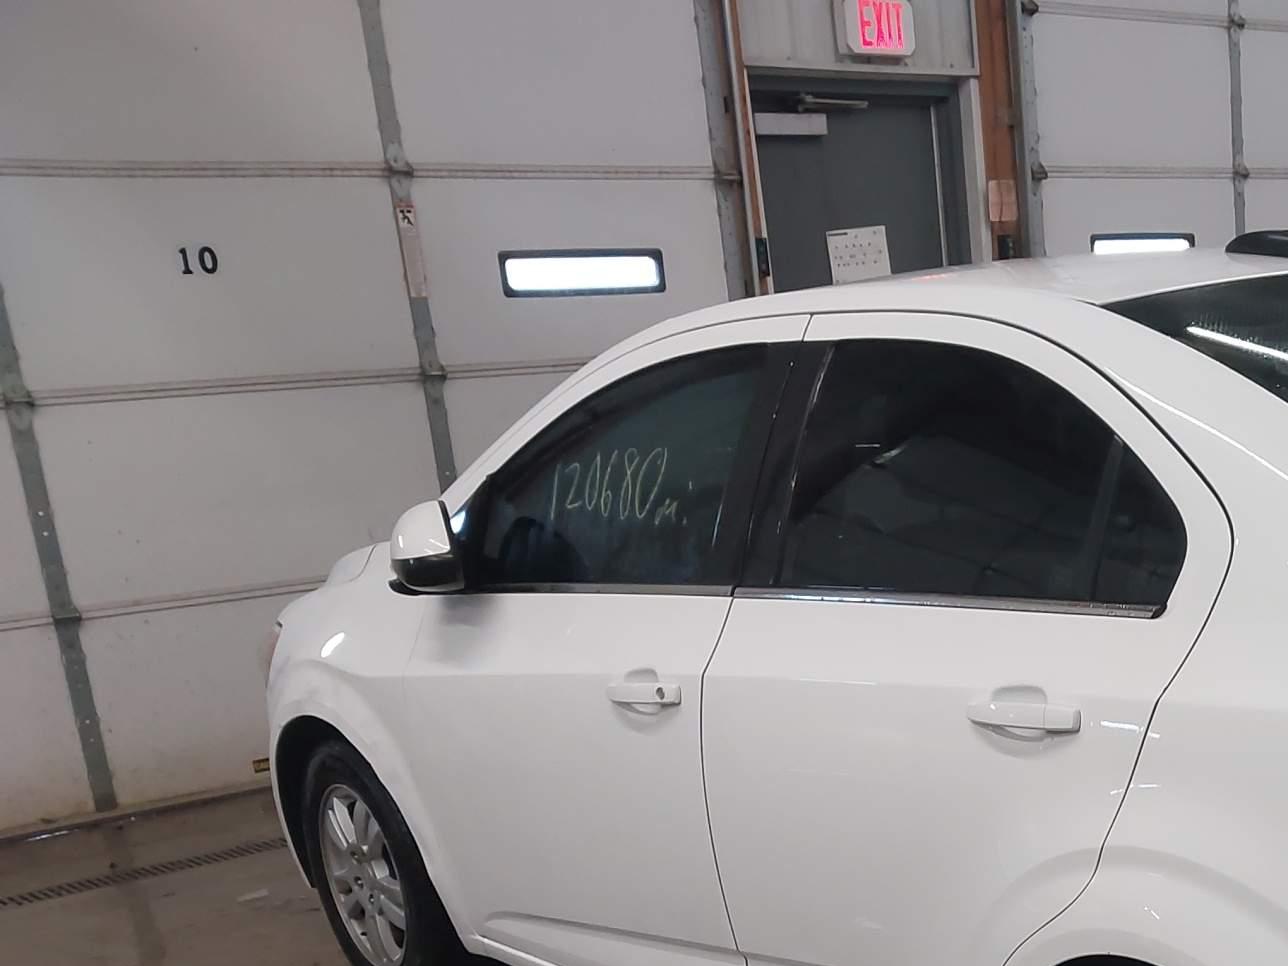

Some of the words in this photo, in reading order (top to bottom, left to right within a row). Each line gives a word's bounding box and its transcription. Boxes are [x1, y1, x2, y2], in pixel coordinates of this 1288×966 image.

[857, 0, 904, 48] EXIT
[178, 246, 218, 275] 10
[550, 447, 668, 521] 120680
